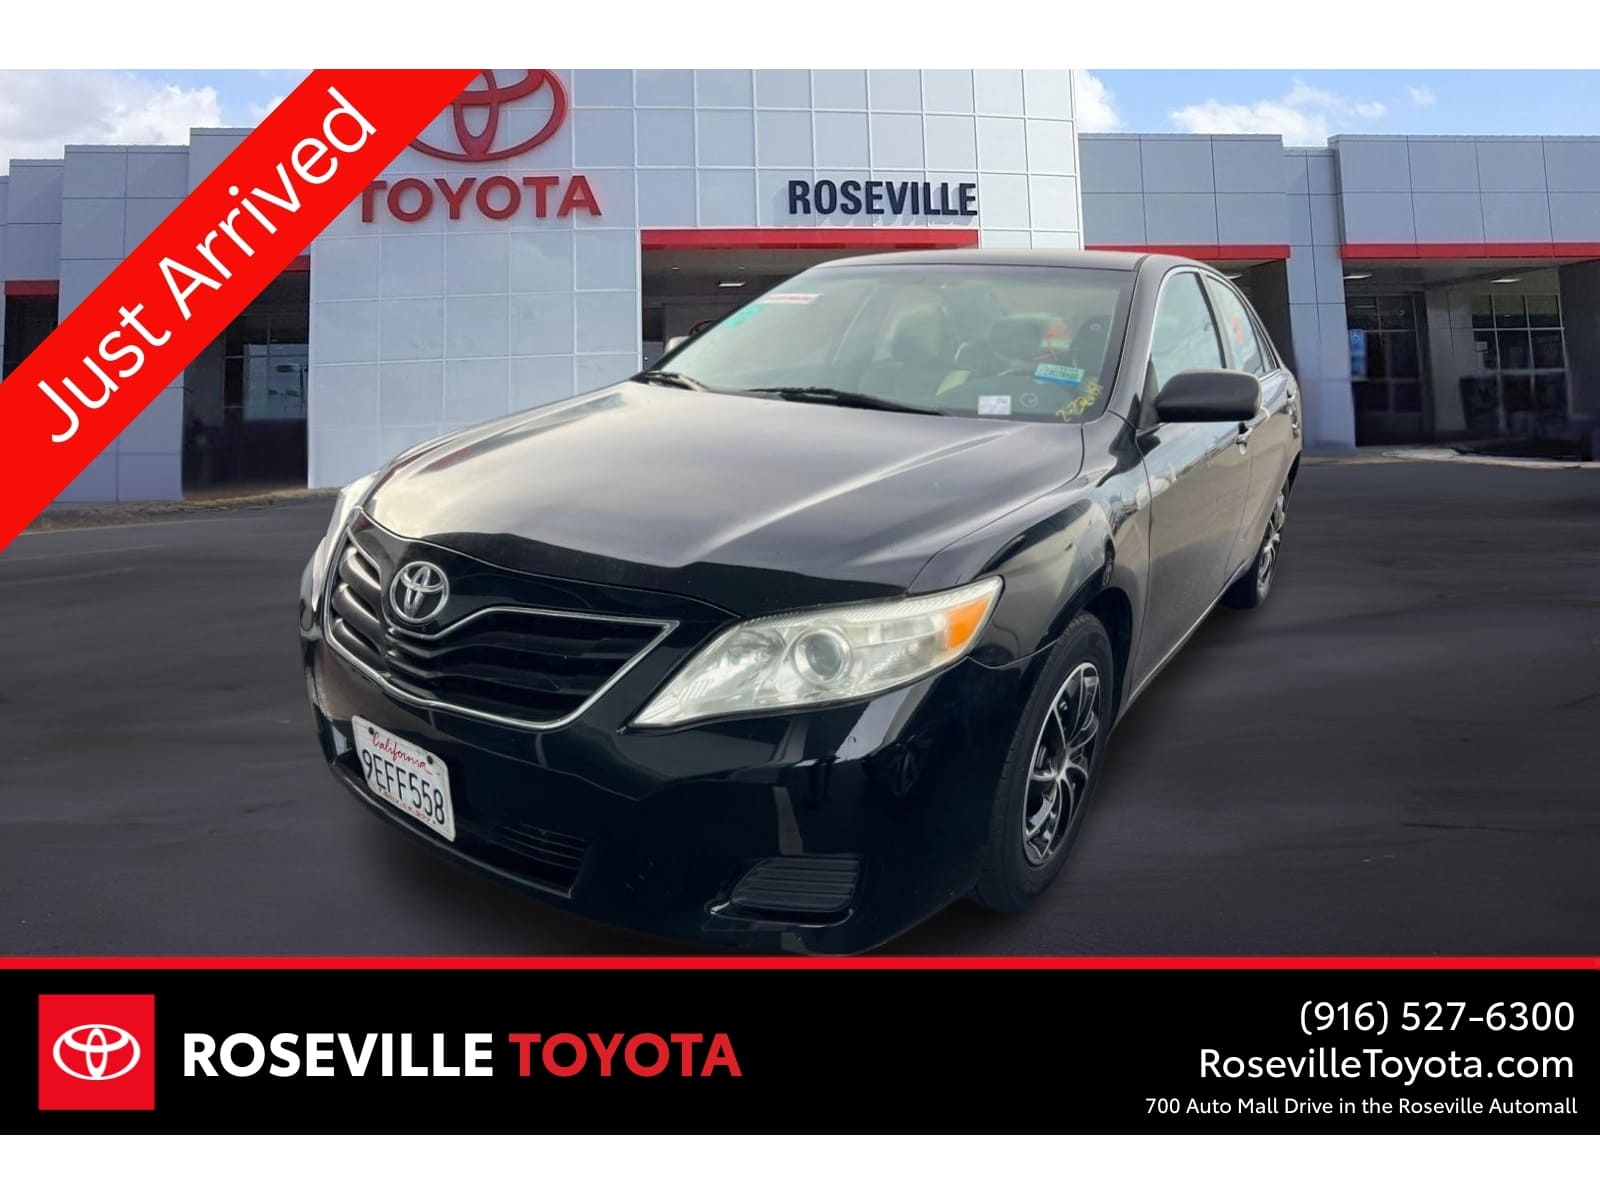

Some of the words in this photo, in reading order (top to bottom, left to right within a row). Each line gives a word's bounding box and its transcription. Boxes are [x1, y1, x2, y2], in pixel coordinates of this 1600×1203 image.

[361, 175, 602, 223] TOYOTA
[788, 180, 978, 216] ROSEVILLE
[371, 731, 433, 776] California
[361, 748, 446, 825] 9EFF558
